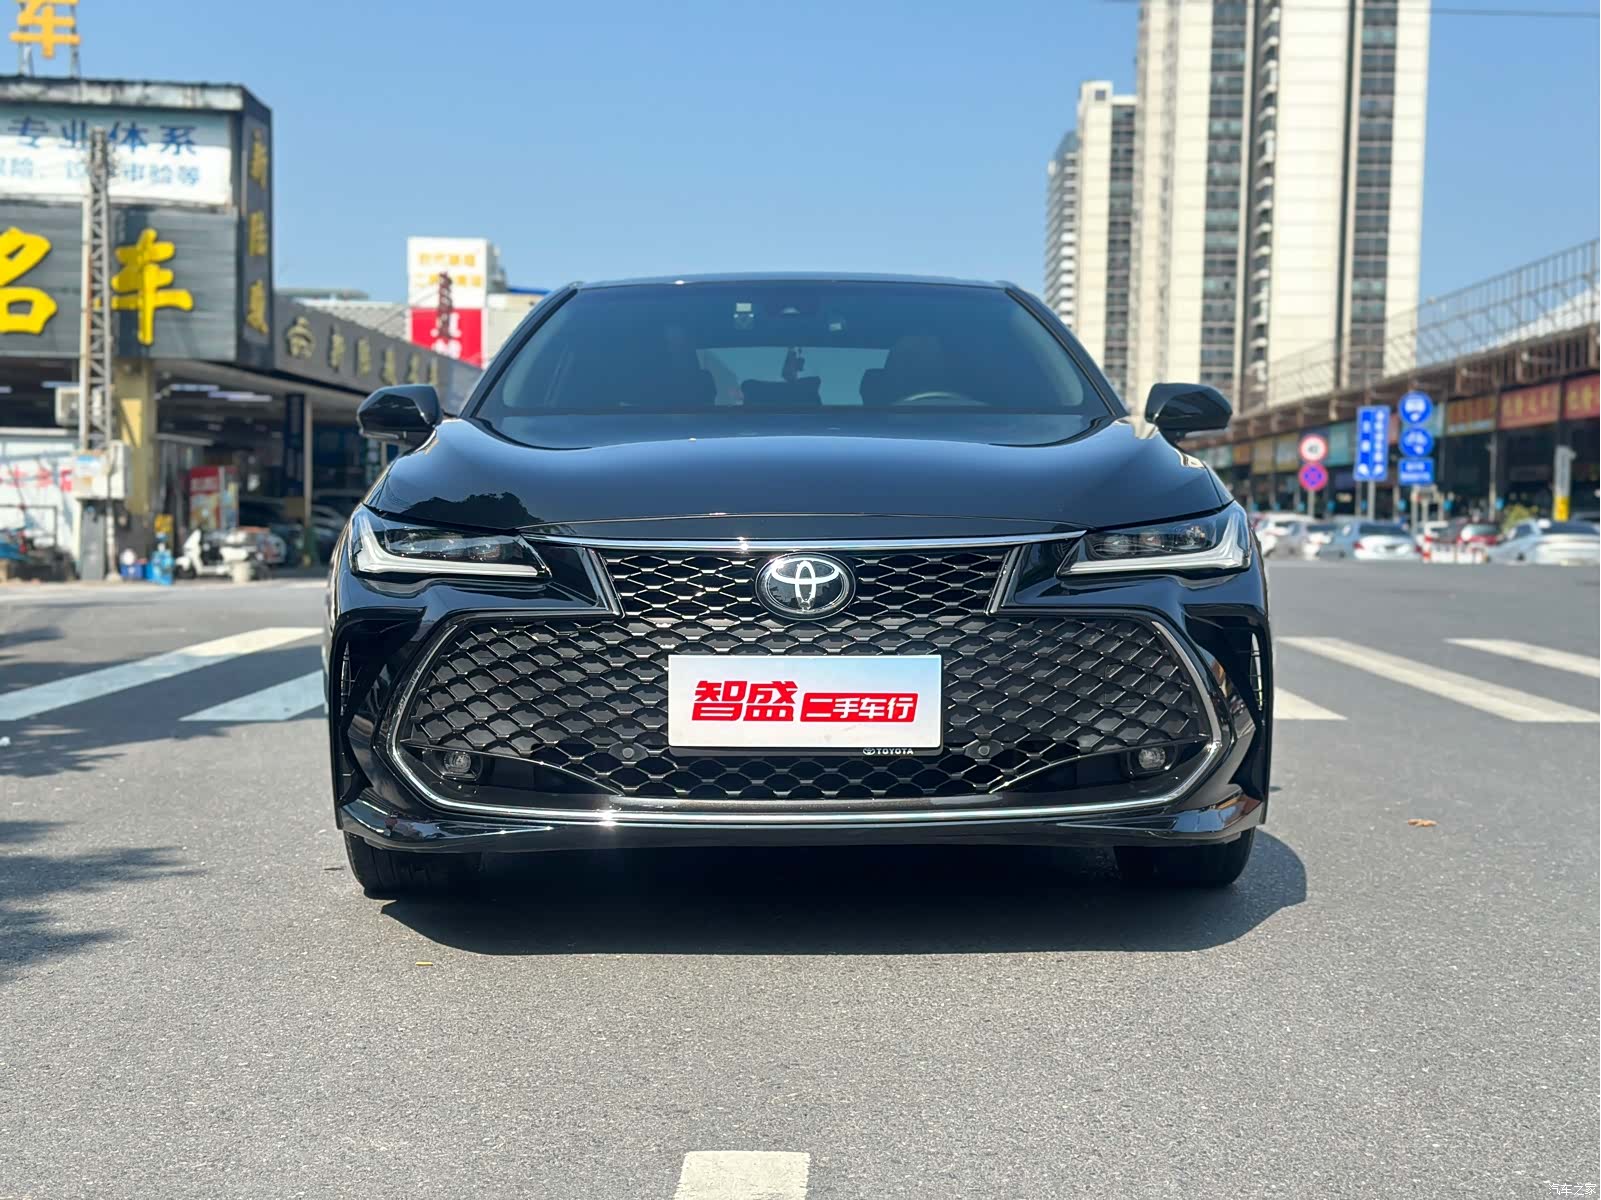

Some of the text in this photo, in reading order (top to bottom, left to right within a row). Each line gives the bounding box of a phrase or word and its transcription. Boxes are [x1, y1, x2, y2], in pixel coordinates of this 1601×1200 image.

[9, 0, 80, 58] 车
[7, 115, 198, 155] 专业体系
[691, 680, 915, 722] 智盛 二手车行
